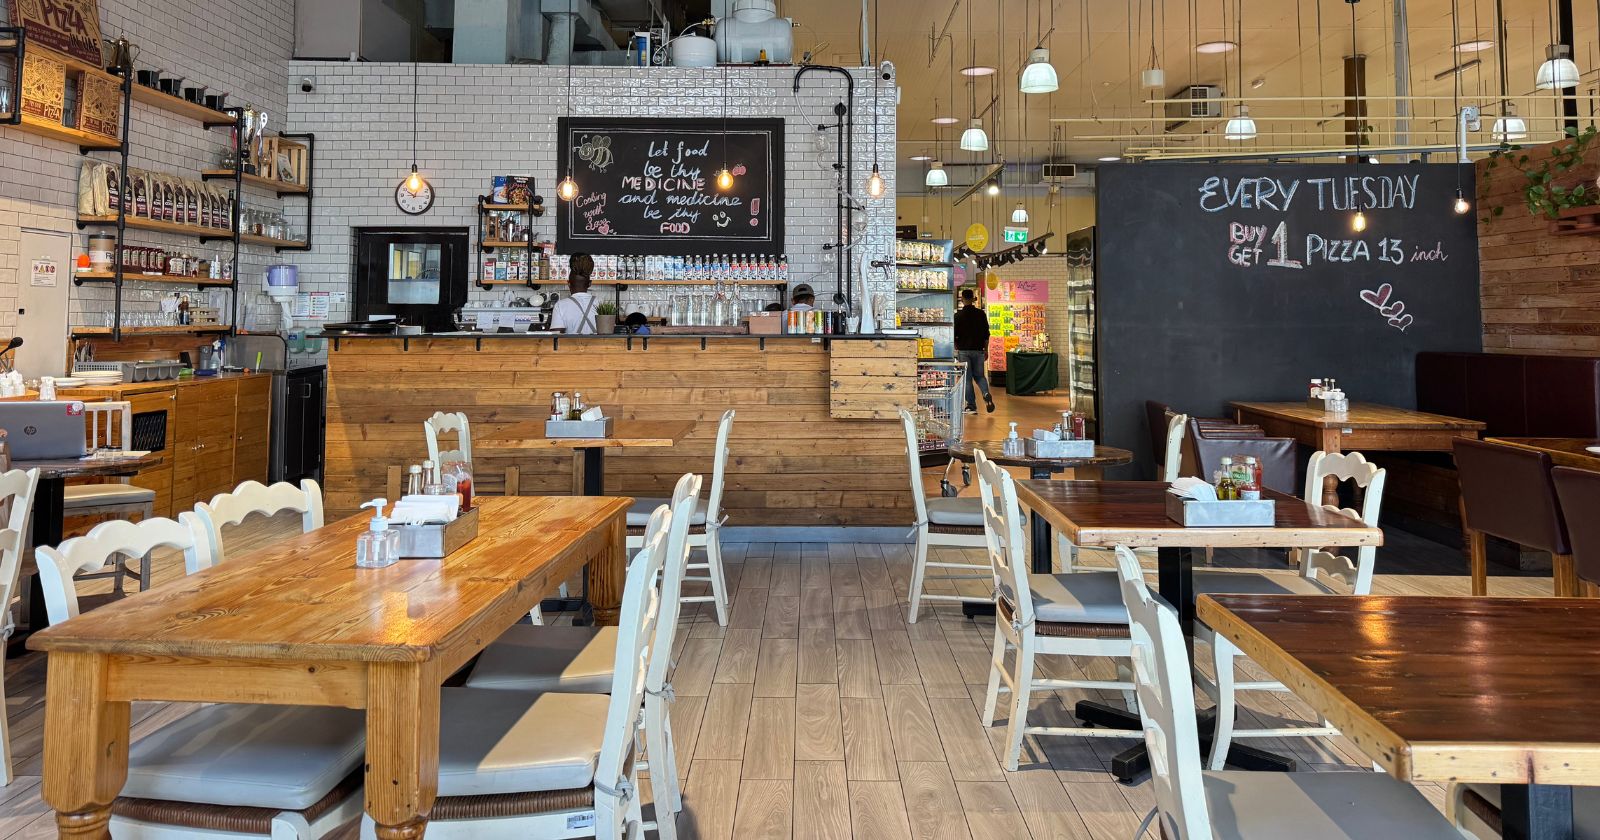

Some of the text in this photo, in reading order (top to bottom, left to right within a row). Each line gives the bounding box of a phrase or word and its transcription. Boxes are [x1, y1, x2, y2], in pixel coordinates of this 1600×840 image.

[41, 0, 88, 36] PIZZA
[648, 140, 710, 164] Let food
[643, 161, 701, 180] be thy
[621, 175, 706, 191] MEDICINE
[575, 191, 607, 208] Cooking
[618, 190, 742, 206] and medicine
[1198, 174, 1420, 212] EVERY TUESDAY
[583, 203, 604, 218] with
[643, 206, 701, 223] be thy
[660, 222, 691, 234] FOOD
[1229, 221, 1449, 269] BUY 1 PIZZA 13 inch
[1228, 244, 1263, 268] GET
